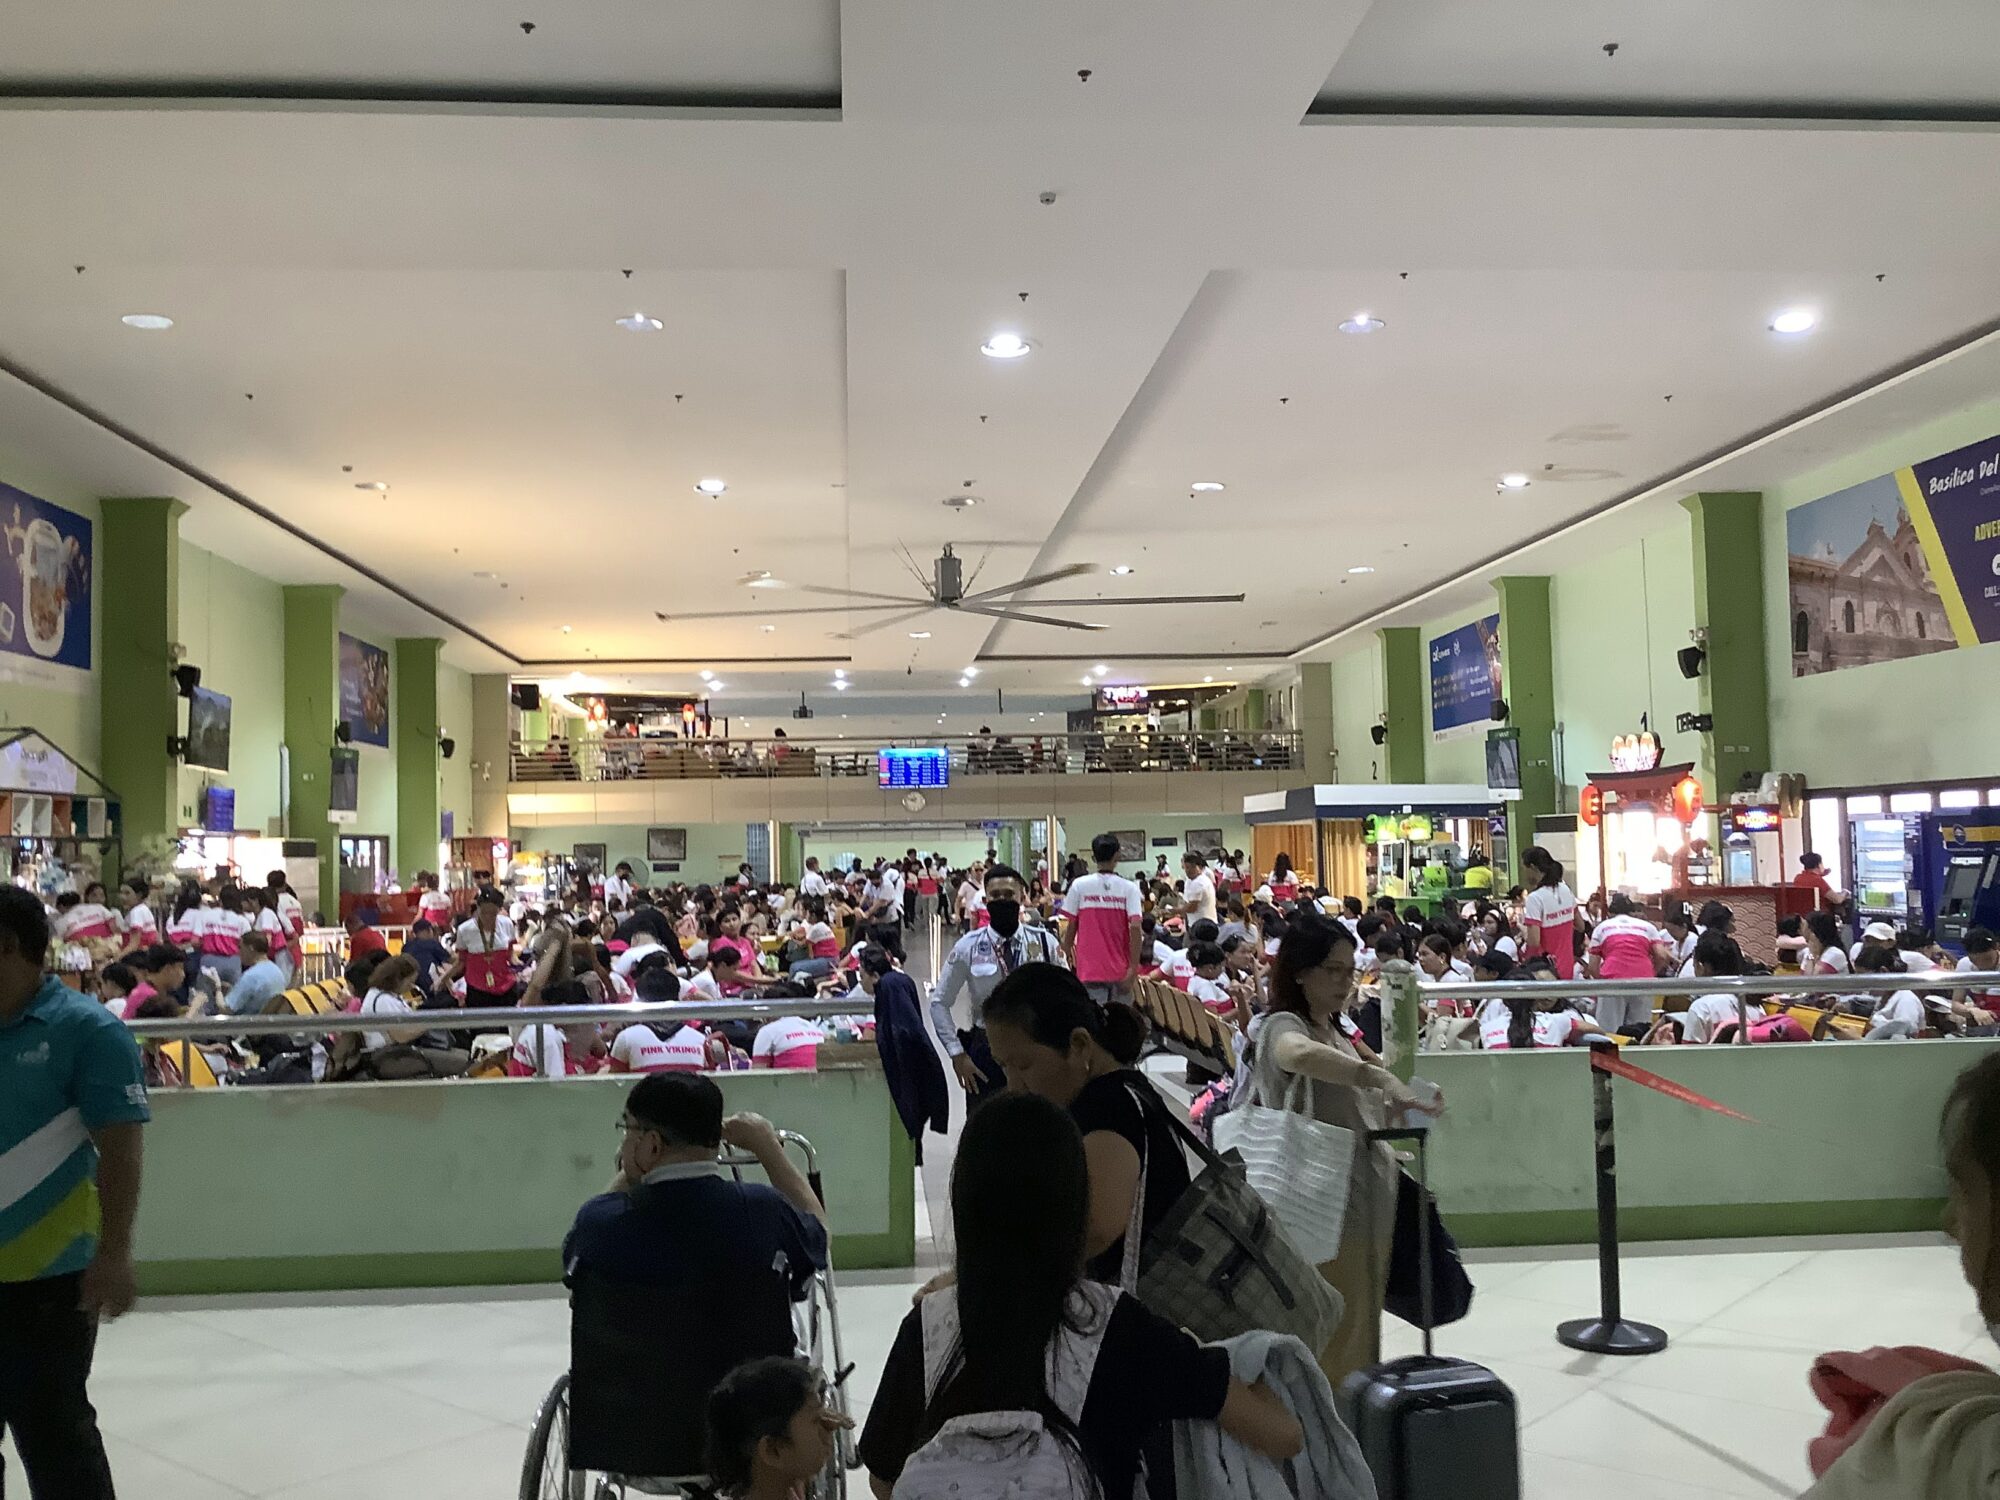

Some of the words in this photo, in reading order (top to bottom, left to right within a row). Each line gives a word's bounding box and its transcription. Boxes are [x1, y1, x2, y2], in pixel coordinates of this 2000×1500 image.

[1929, 467, 1974, 495] Basilica
[1979, 453, 2000, 480] Del
[1975, 520, 2000, 541] ADVE
[1640, 711, 1648, 732] 1
[1372, 760, 1378, 780] 2
[786, 1031, 804, 1040] PINK
[640, 1045, 664, 1056] PINK
[665, 1044, 701, 1055] VIKINGS
